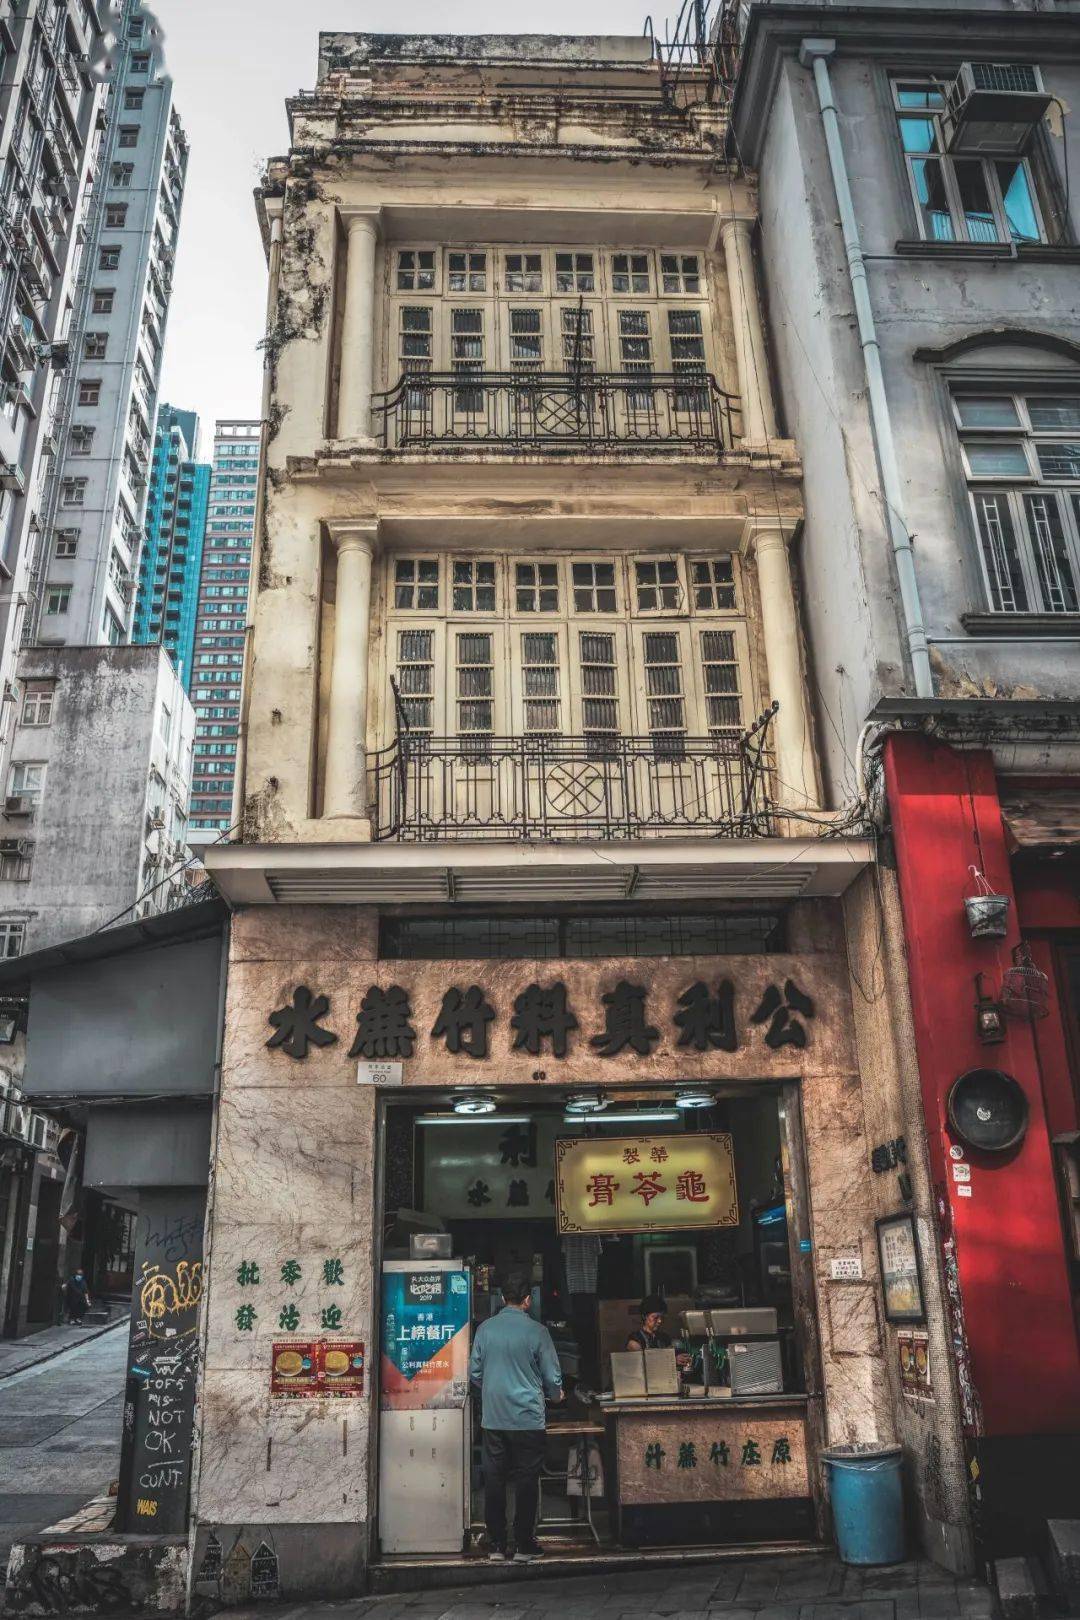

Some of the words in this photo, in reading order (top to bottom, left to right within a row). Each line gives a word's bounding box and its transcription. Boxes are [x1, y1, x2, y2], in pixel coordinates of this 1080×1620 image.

[372, 1074, 387, 1083] 60
[586, 1170, 710, 1207] 龜苓膏
[396, 1324, 456, 1341] 上榜餐厅
[148, 1410, 185, 1426] NOT
